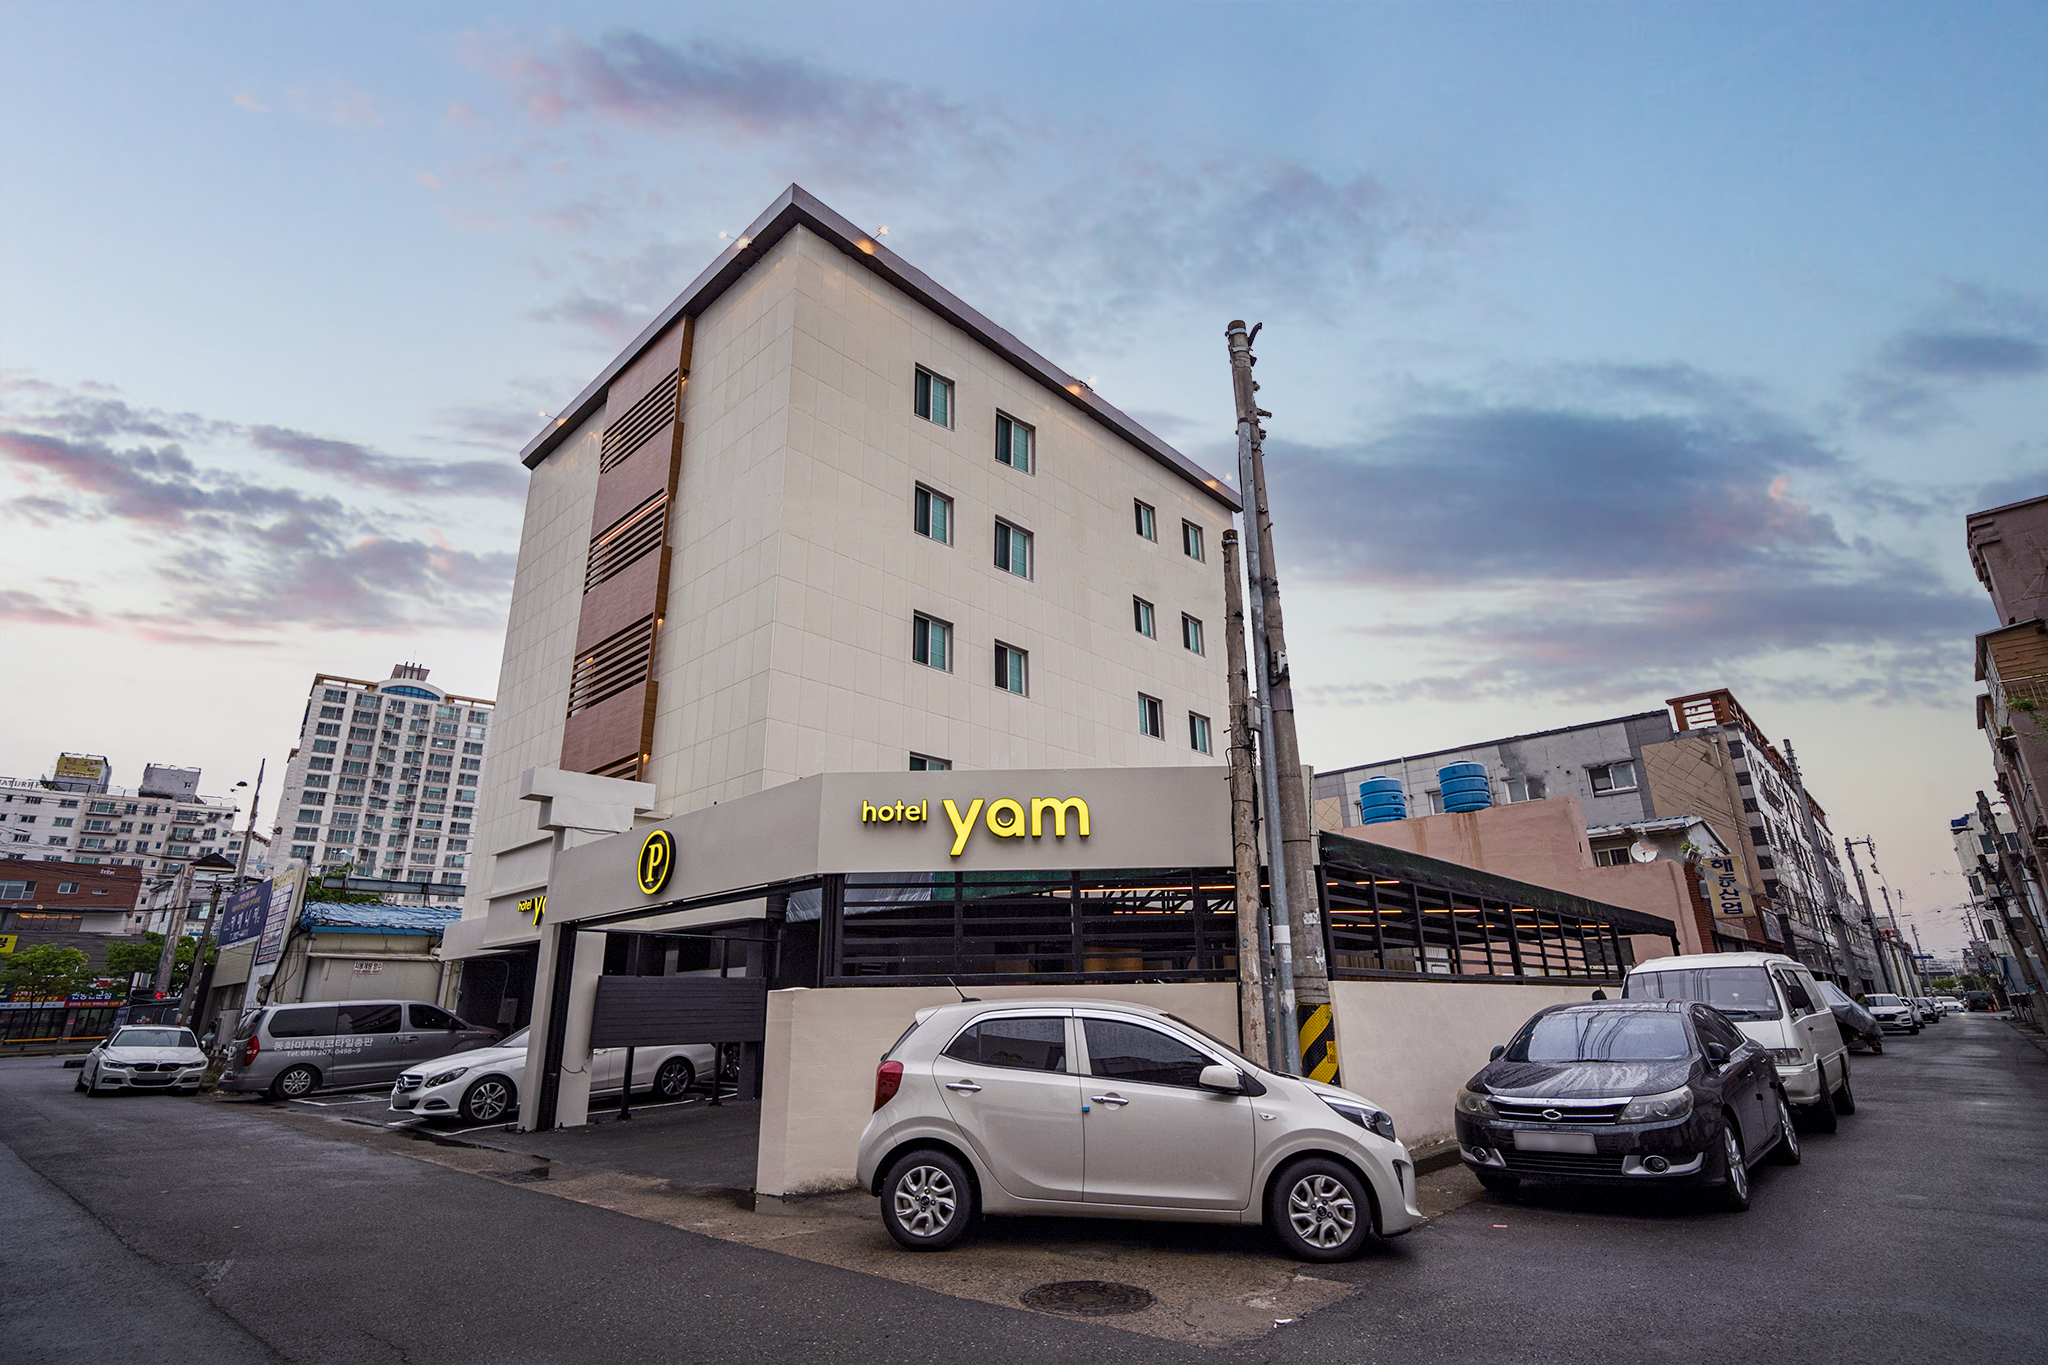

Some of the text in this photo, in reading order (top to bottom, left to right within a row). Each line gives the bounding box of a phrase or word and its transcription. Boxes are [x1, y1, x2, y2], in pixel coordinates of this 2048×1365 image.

[0, 779, 33, 788] ATURE
[862, 797, 1090, 857] hotel yam
